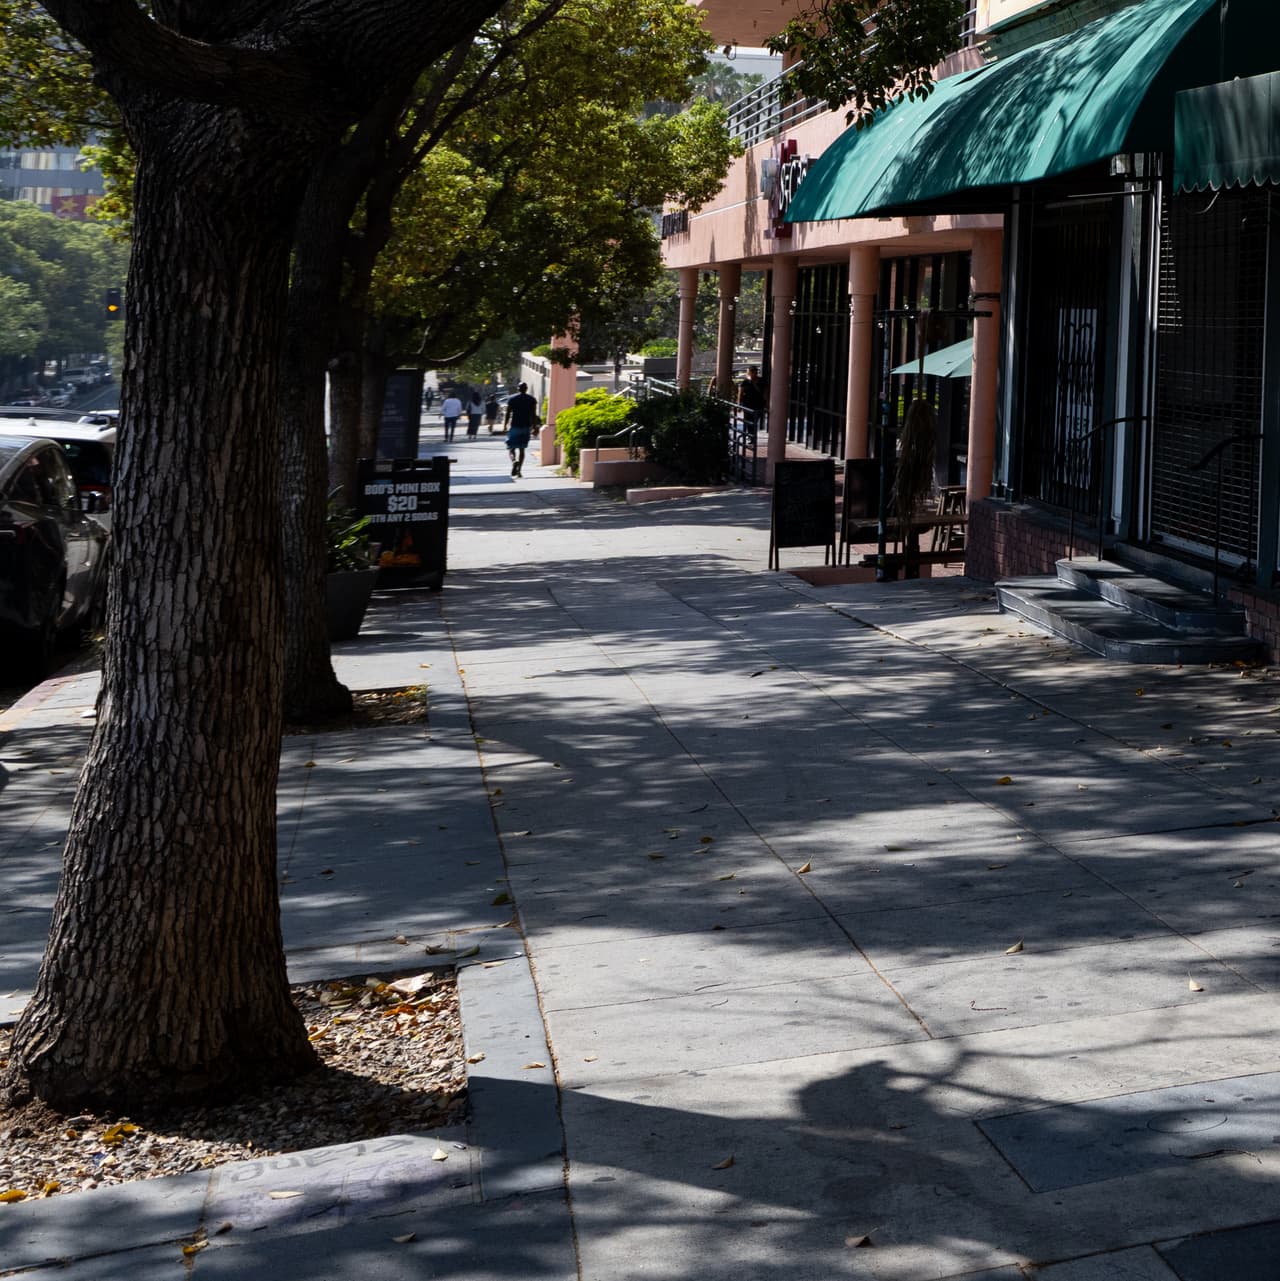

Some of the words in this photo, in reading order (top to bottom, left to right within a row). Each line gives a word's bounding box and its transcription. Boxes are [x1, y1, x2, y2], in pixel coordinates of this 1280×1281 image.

[395, 483, 419, 494] MINI
[420, 482, 441, 493] BOX
[387, 495, 418, 512] $20
[387, 513, 404, 522] ANY
[404, 513, 411, 522] 2
